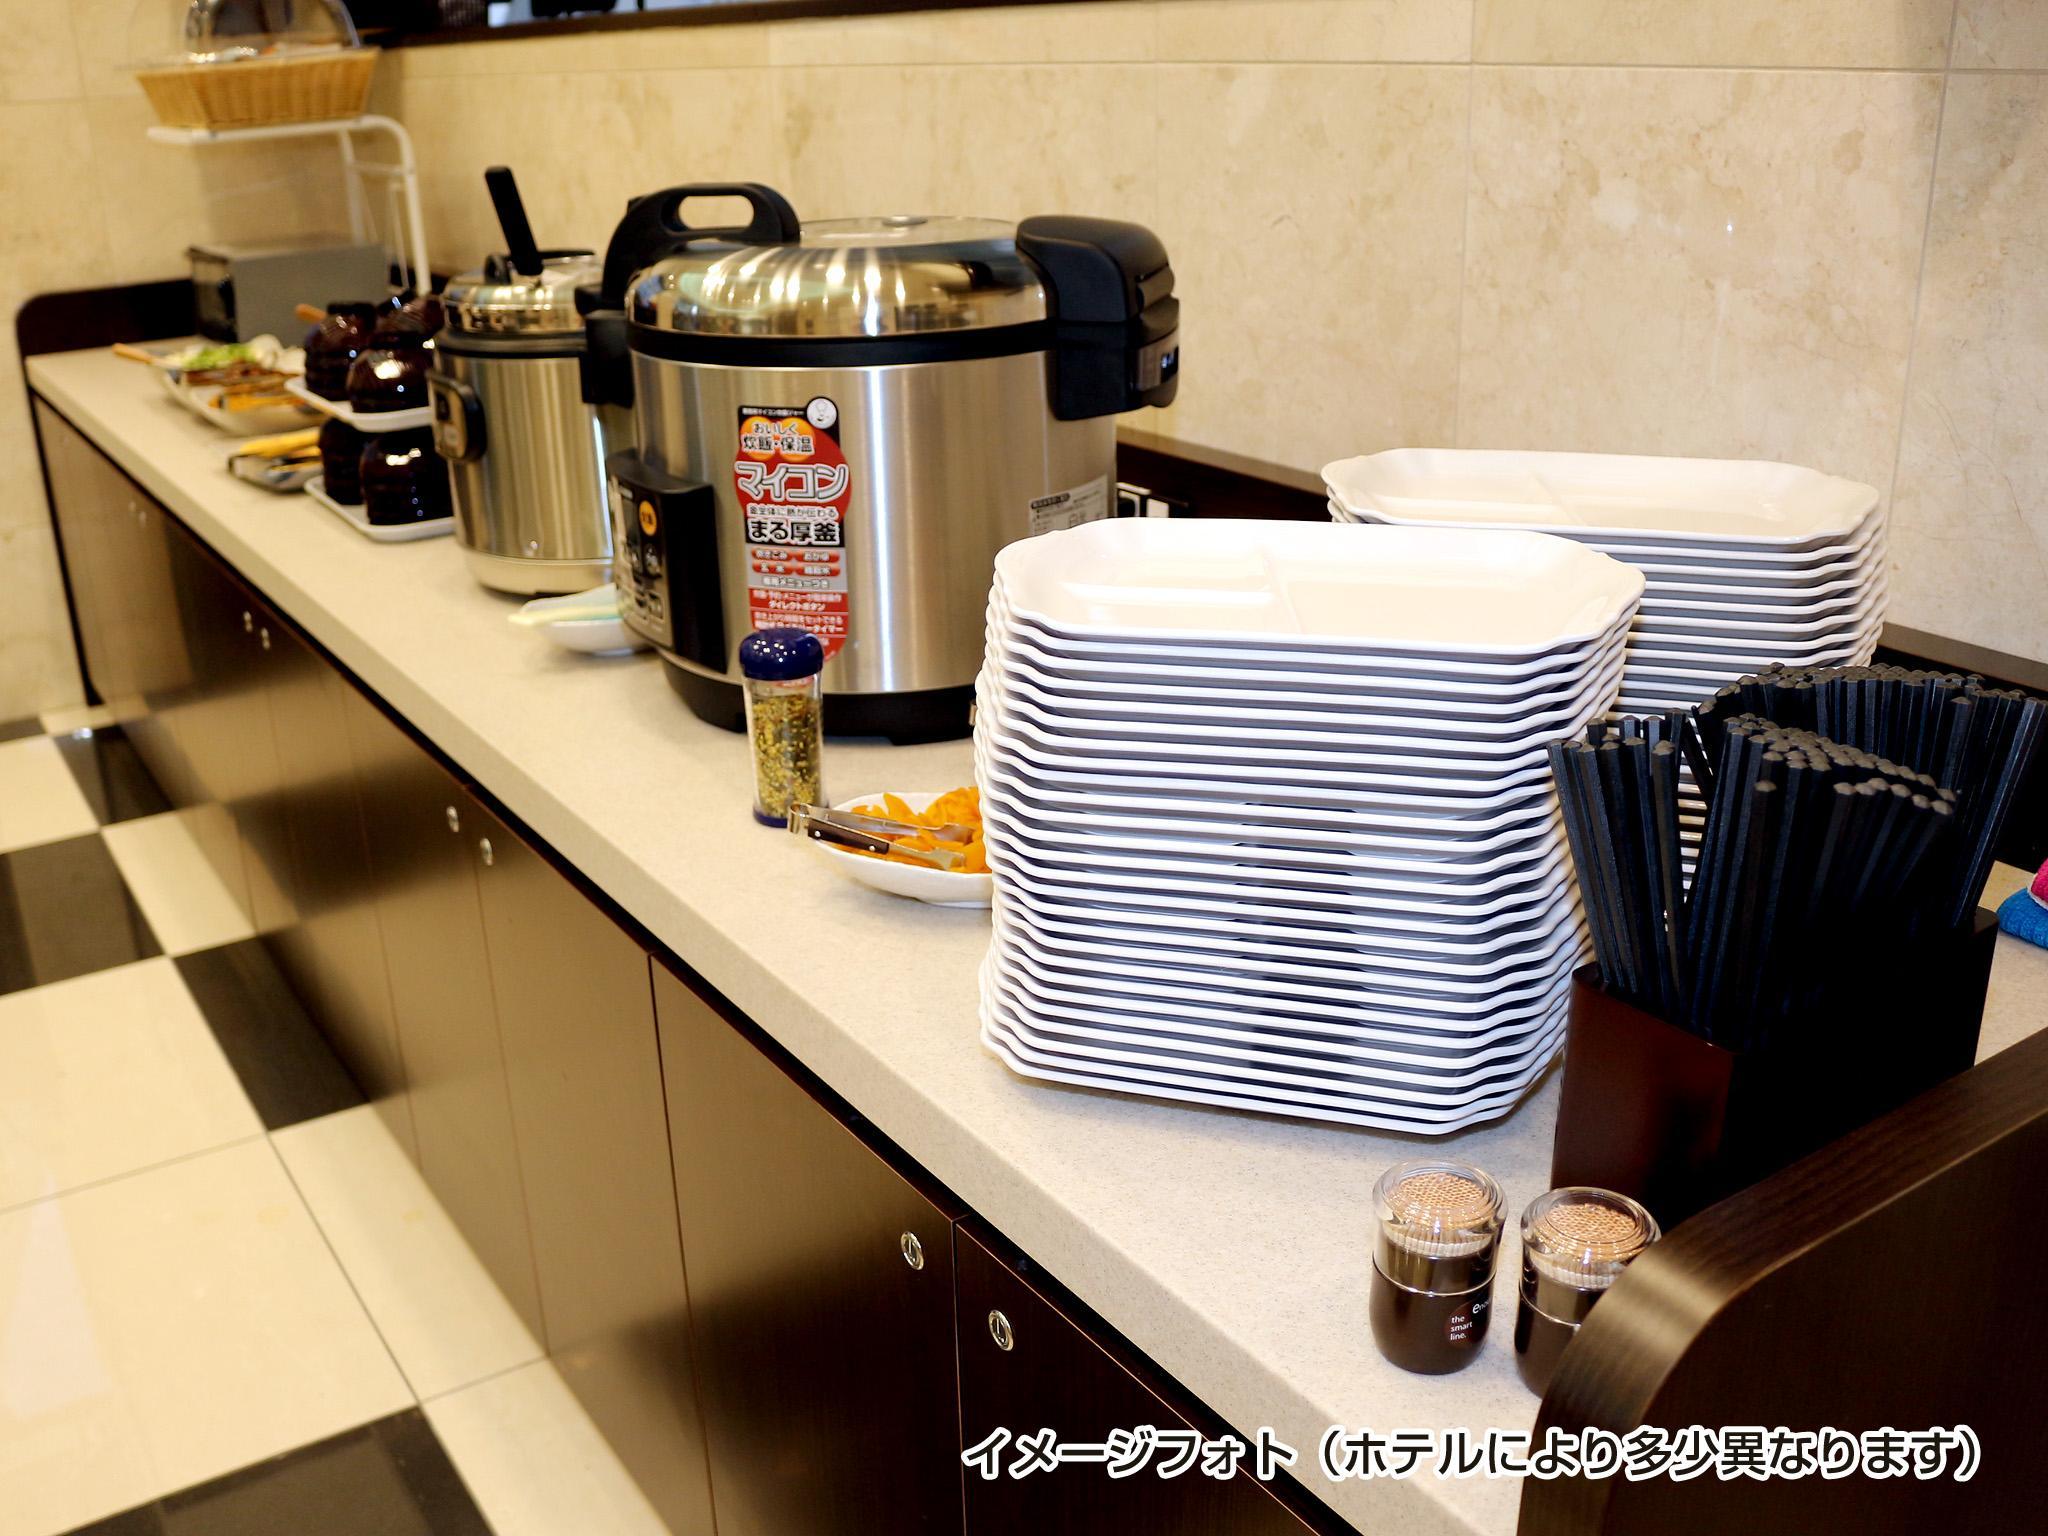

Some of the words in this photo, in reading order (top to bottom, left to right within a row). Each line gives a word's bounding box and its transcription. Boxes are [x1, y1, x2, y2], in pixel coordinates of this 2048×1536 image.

[753, 422, 799, 434] おいしく
[742, 435, 814, 453] 炊飯・保温
[735, 461, 849, 502] マイコン
[749, 519, 839, 543] まる厚釜
[1450, 1321, 1473, 1333] smart
[1451, 1316, 1465, 1324] the
